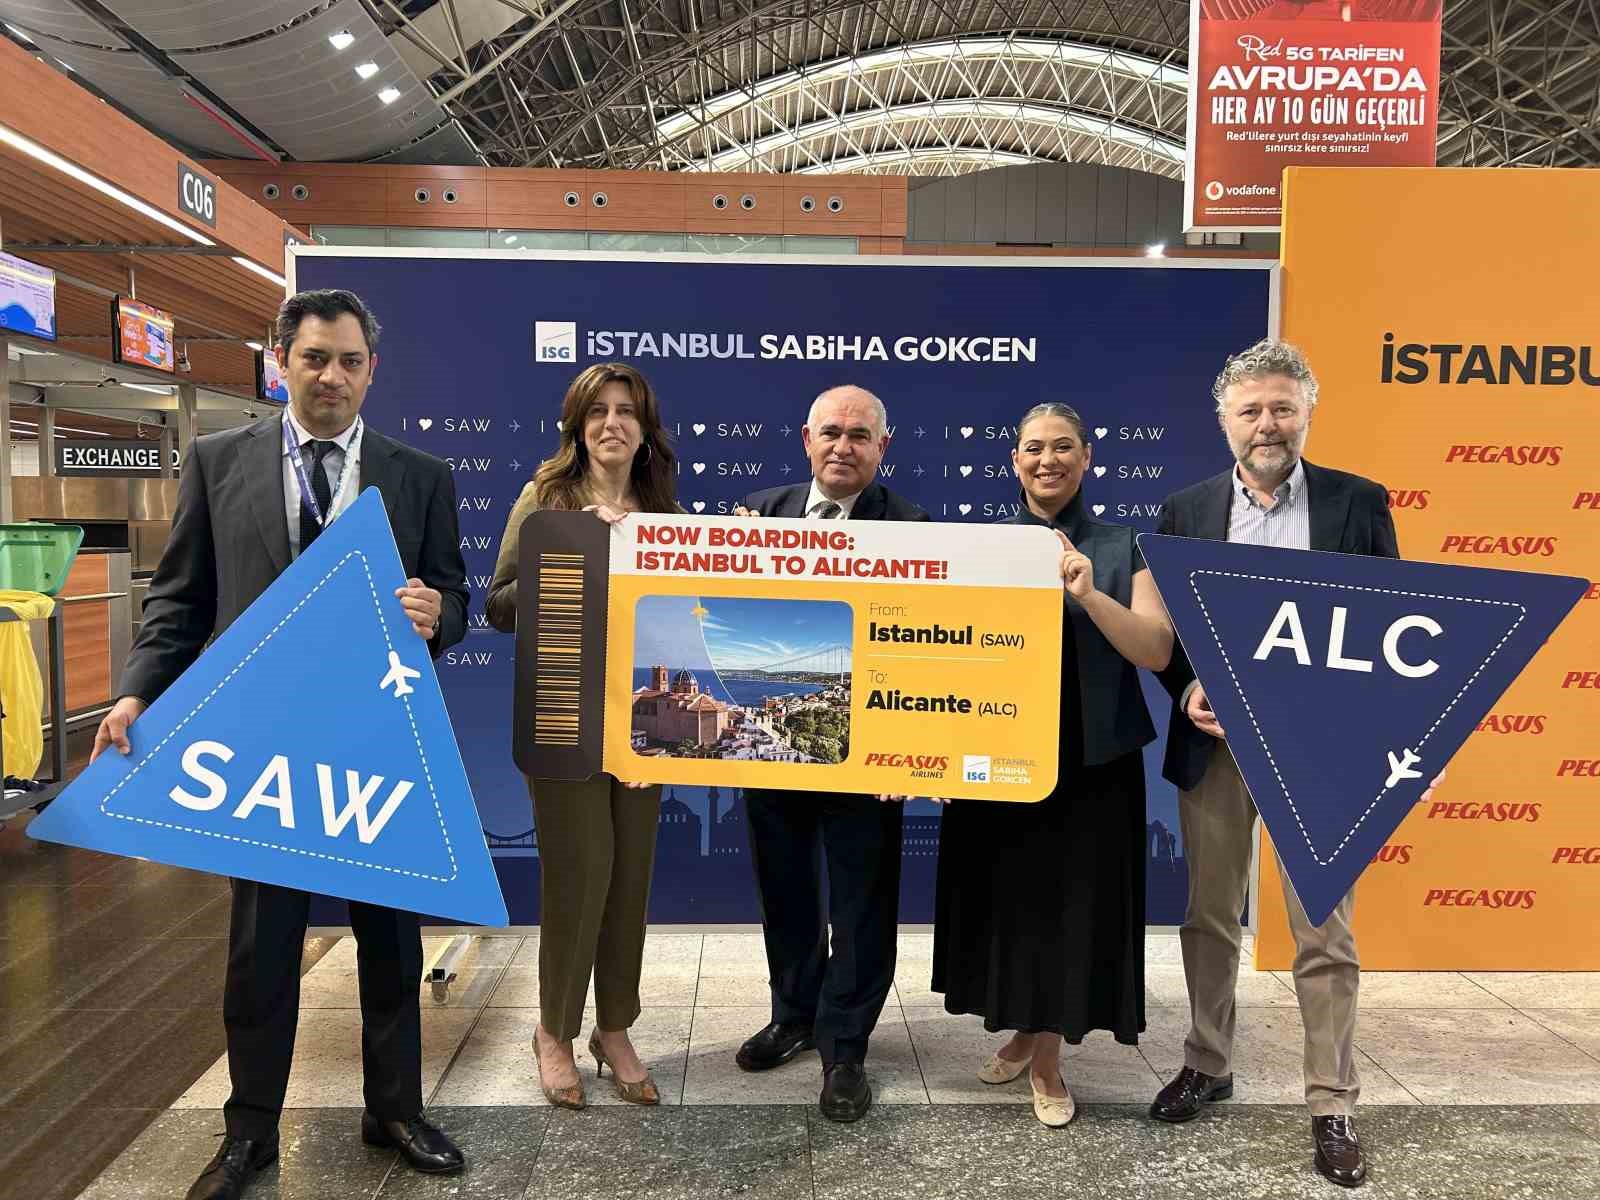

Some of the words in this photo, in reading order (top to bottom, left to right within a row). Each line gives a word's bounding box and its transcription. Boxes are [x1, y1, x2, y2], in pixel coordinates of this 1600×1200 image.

[1237, 35, 1284, 61] Red
[1286, 47, 1314, 61] 5G
[1319, 44, 1404, 62] TARİFEN
[1208, 65, 1428, 92] AVRUPA'DA
[1211, 96, 1247, 125] HER
[1253, 97, 1277, 125] AY
[1282, 97, 1304, 125] 10
[1310, 94, 1348, 125] GÜN
[1355, 95, 1425, 130] GEÇERLİ
[1277, 132, 1300, 143] yurt
[1322, 132, 1382, 144] seyahatinin
[1383, 132, 1409, 144] keyfi
[1304, 144, 1328, 153] kere
[182, 172, 214, 220] C06
[1226, 184, 1276, 196] vodafone
[541, 346, 571, 360] ISG
[444, 418, 490, 432] SAW
[717, 423, 763, 437] SAW
[1119, 427, 1164, 440] SAW
[63, 448, 159, 467] EXCHANGE
[1445, 445, 1563, 466] PEGASUS
[445, 458, 491, 472] SAW
[717, 462, 763, 476] SAW
[984, 465, 1009, 478] SA
[1118, 465, 1163, 479] SAW
[459, 497, 491, 511] AW
[1116, 504, 1162, 517] SAW
[459, 536, 491, 550] AW
[636, 525, 702, 546] NOW
[708, 527, 855, 551] BOARDING:
[1440, 535, 1557, 556] PEGASUS
[636, 551, 763, 574] ISTANBUL
[771, 555, 806, 575] TO
[812, 556, 948, 580] ALICANTE!
[869, 602, 908, 617] From:
[869, 621, 974, 645] Istanbul
[979, 633, 1026, 650] (SAW)
[1252, 600, 1444, 678] ALC
[446, 652, 492, 666] SAW
[867, 669, 889, 685] To:
[865, 688, 973, 714] Alicante
[977, 701, 1018, 719] (ALC)
[864, 752, 950, 771] PEGASUS
[910, 770, 945, 779] AIRLINES
[966, 772, 987, 781] ISG
[168, 740, 416, 845] SAW
[1427, 802, 1542, 822] PEGASUS
[1423, 889, 1537, 909] PEGASUS
